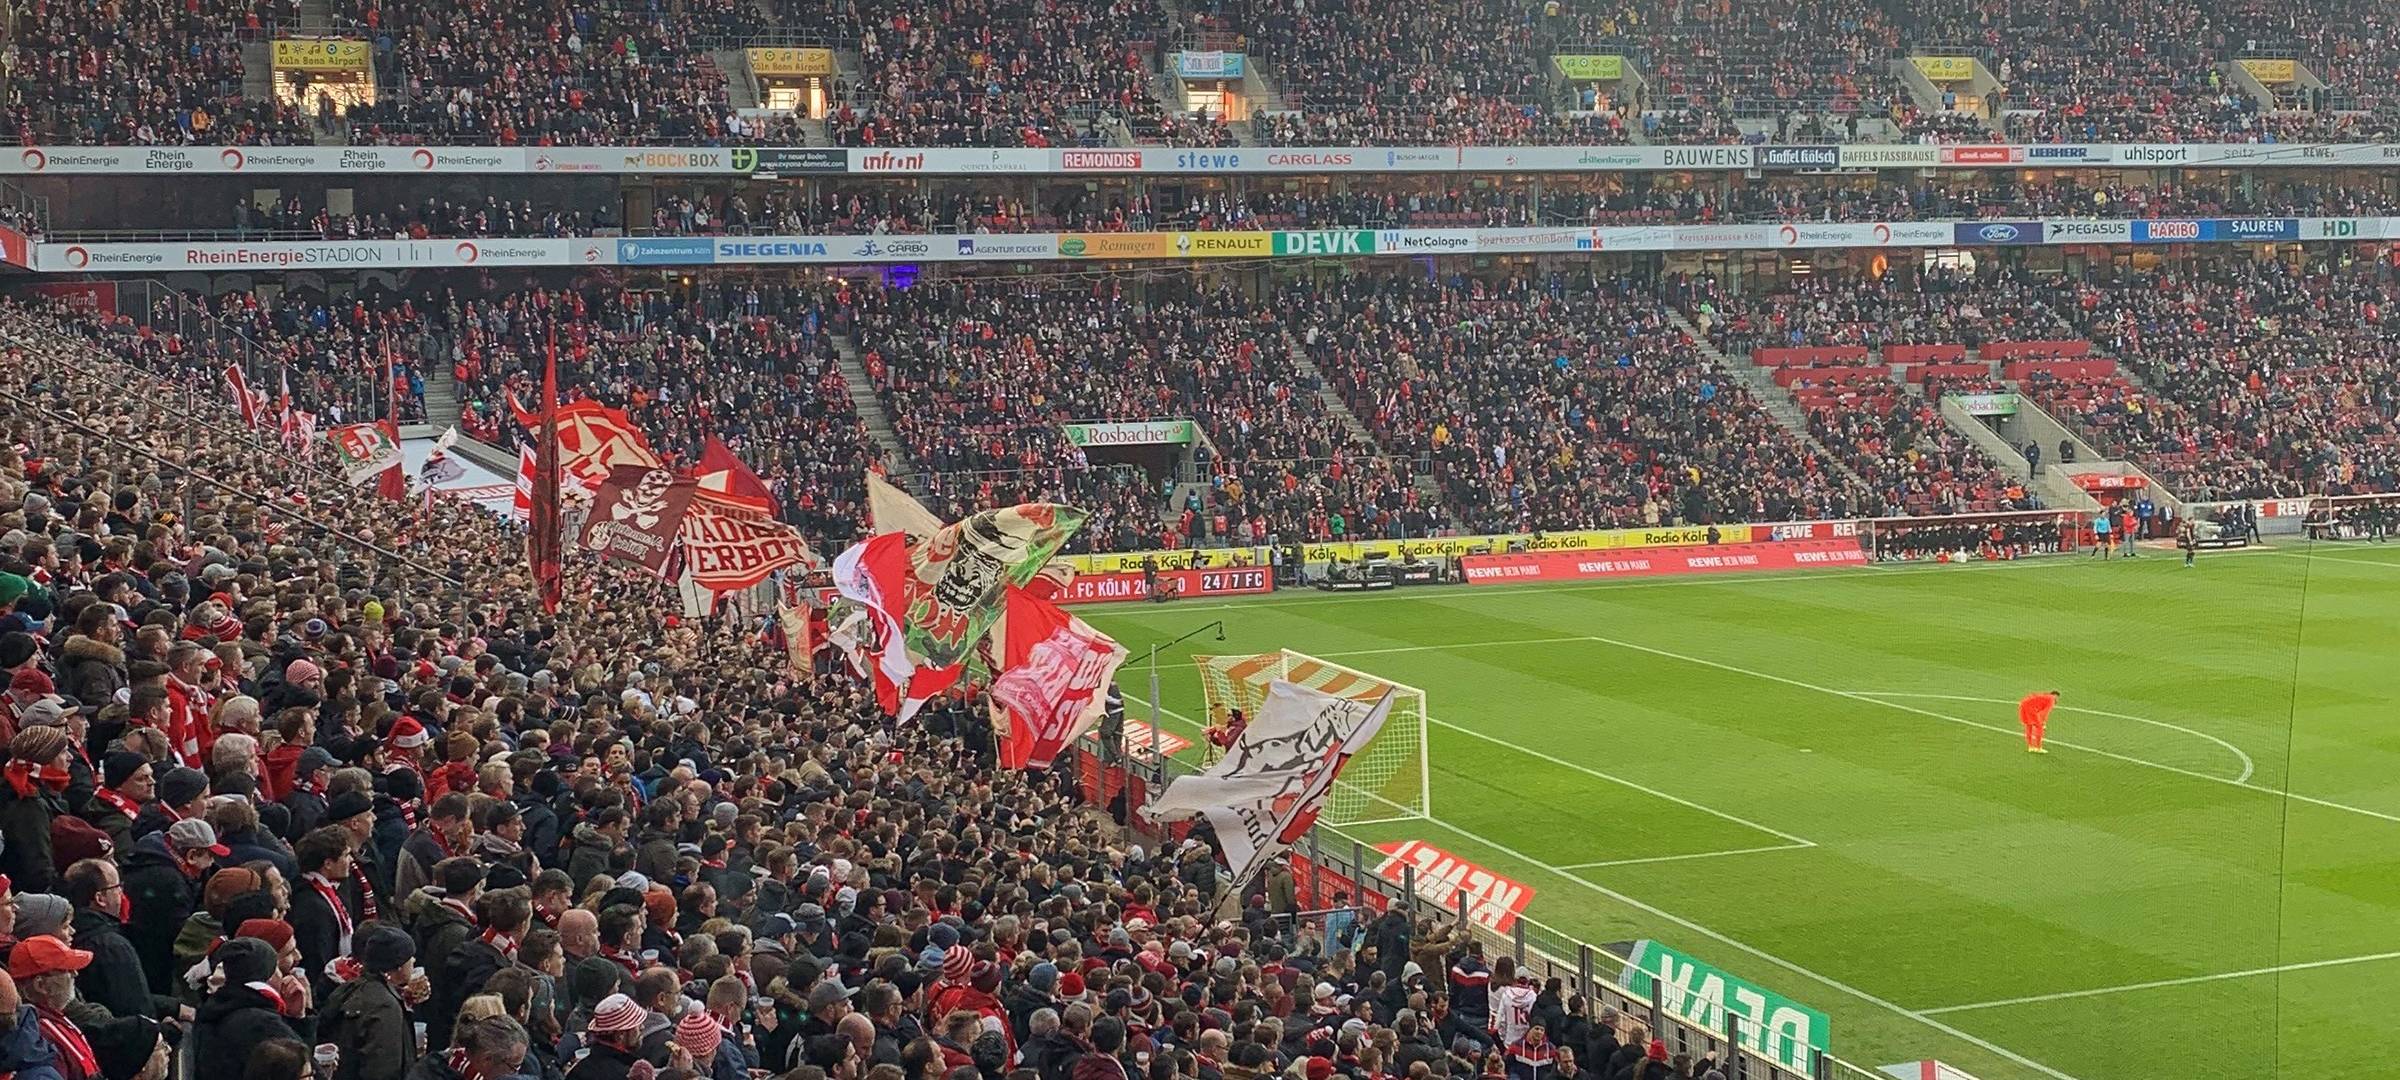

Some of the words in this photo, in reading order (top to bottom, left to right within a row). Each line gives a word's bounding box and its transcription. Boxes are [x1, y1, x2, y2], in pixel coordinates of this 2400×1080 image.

[279, 56, 300, 65] Köln
[303, 56, 325, 65] Bonn
[328, 56, 363, 67] Airport
[795, 63, 826, 72] Airport
[149, 150, 185, 160] Rhein
[344, 149, 378, 160] Rhein
[1664, 149, 1748, 166] BAUWENS
[1768, 149, 1800, 165] Gaffel
[1801, 149, 1835, 165] Kölsch
[1842, 150, 1878, 162] GAFFELS
[1880, 150, 1936, 162] FASSBRAUSE
[2029, 147, 2087, 157] LIEBHERR
[2124, 146, 2187, 164] uhlsport
[49, 155, 120, 166] RheinEnergie
[145, 159, 194, 170] Energie
[247, 155, 315, 166] RheinEnergie
[340, 158, 386, 170] Energie
[437, 155, 502, 166] RheinEnergie
[646, 154, 720, 167] BOCKBOX
[1064, 153, 1136, 168] REMONDIS
[1178, 151, 1239, 168] stewe
[1267, 154, 1353, 165] CARGLASS
[1988, 226, 2010, 241] Ford
[2067, 223, 2126, 235] PEGASUS
[2149, 222, 2199, 239] HARIBO
[2231, 220, 2284, 233] SAUREN
[2323, 220, 2358, 237] HDI
[1403, 235, 1469, 250] NetCologne
[1478, 233, 1527, 247] Sparkasse
[1800, 231, 1852, 242] RheinEnergie
[1893, 230, 1944, 241] RheinEnergie
[719, 243, 827, 257] SIEGENIA
[887, 244, 929, 253] CARBO
[975, 245, 1014, 254] AGENTUR
[1100, 239, 1156, 255] Remagen
[1196, 238, 1264, 250] RENAULT
[1286, 232, 1361, 255] DEVK
[92, 252, 163, 264] RheinEnergie
[187, 247, 382, 266] RheinEnergieSTADION
[481, 248, 546, 258] RheinEnergie
[641, 246, 692, 256] Zahnzentrum
[693, 246, 711, 255] Köln
[1088, 425, 1171, 444] Rosbacher
[2099, 476, 2125, 488] REWE
[1560, 536, 1588, 550] Köln
[1645, 531, 1680, 545] Radio
[1682, 530, 1710, 544] Köln
[1308, 547, 1338, 561] Köln
[1397, 541, 1434, 556] Radio
[1436, 539, 1465, 555] Köln
[1161, 555, 1190, 569] Köln
[1687, 556, 1723, 569] REWE
[1723, 556, 1738, 567] DEIN
[1739, 554, 1759, 566] MARKT
[1794, 550, 1830, 563] REWE
[1830, 550, 1844, 562] DEIN
[1466, 566, 1503, 579] REWE
[1503, 566, 1519, 578] DEIN
[1519, 564, 1542, 577] MARKT
[1578, 560, 1614, 574] REWE
[1614, 560, 1630, 572] DEIN
[1630, 559, 1651, 571] MARKT
[1203, 573, 1240, 589] 24/7
[1246, 572, 1264, 588] FC
[1078, 582, 1094, 598] FC
[1098, 578, 1130, 597] KÖLN
[1399, 846, 1522, 928] REWE
[1660, 953, 1811, 1075] DEVK
